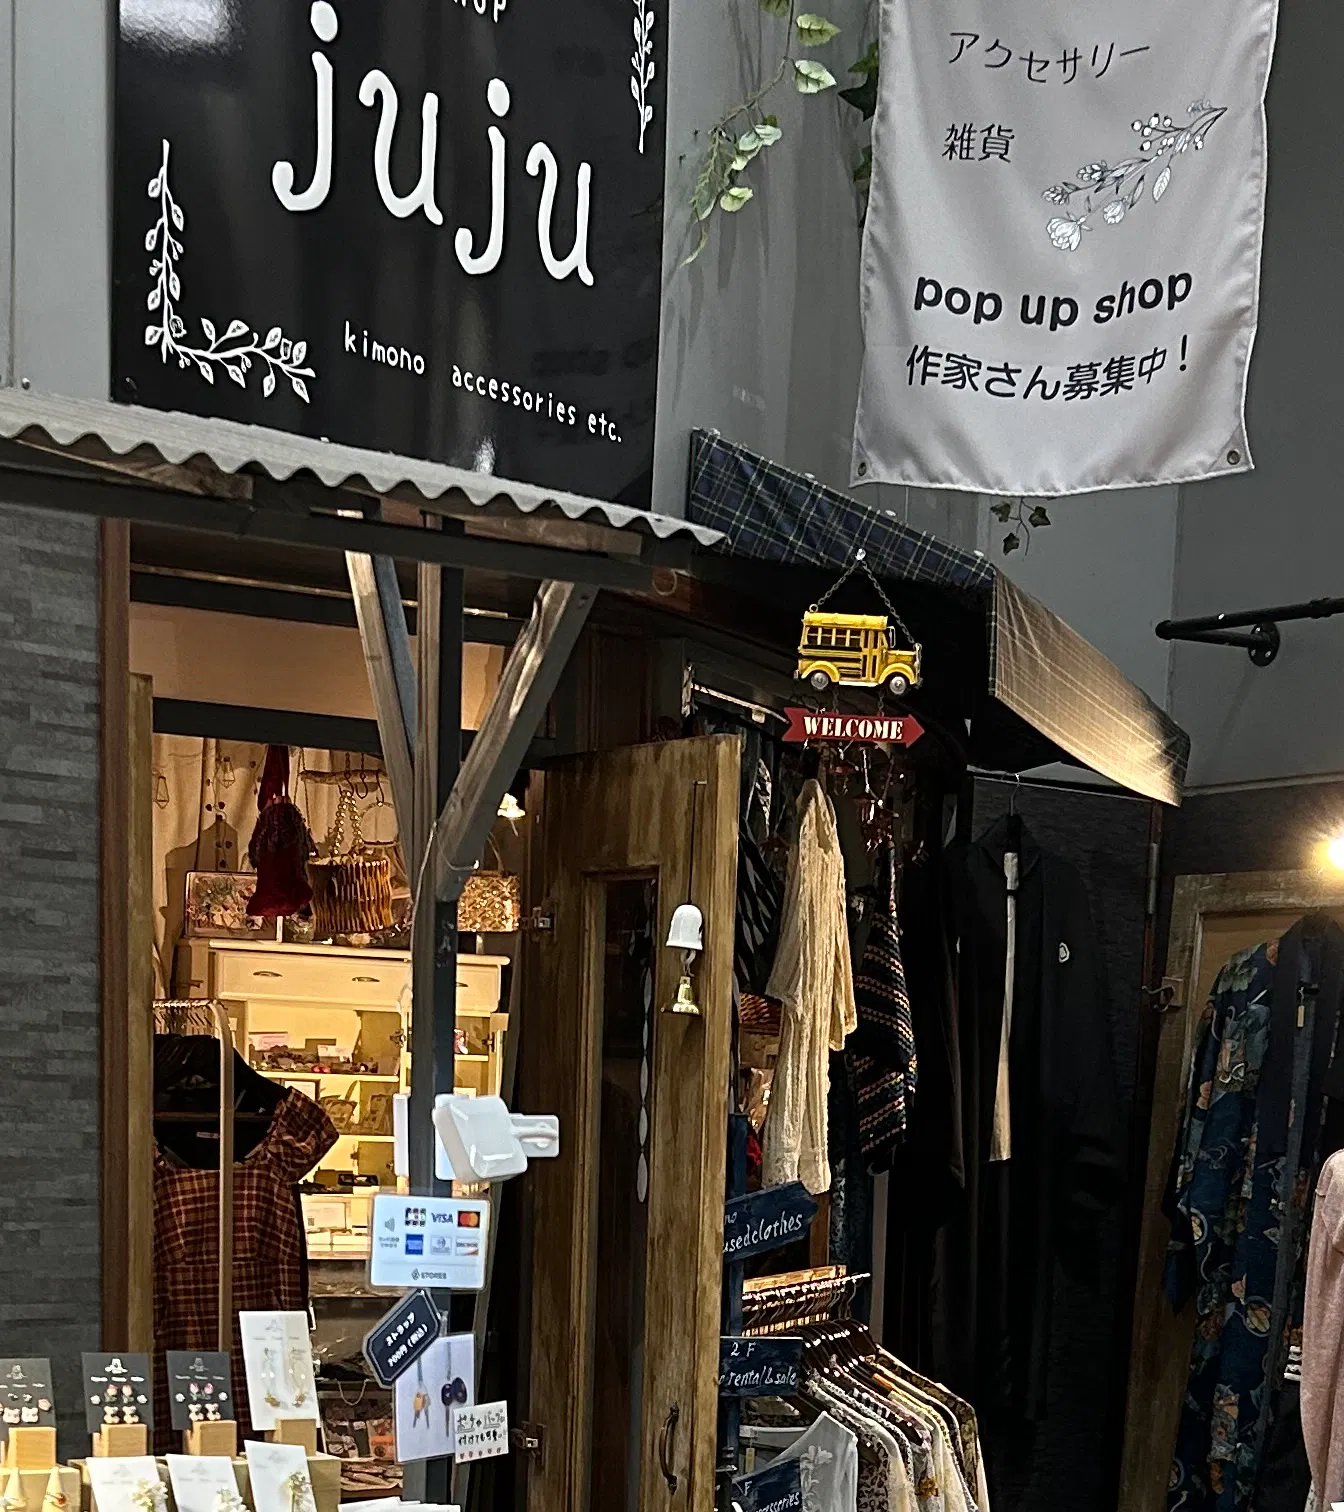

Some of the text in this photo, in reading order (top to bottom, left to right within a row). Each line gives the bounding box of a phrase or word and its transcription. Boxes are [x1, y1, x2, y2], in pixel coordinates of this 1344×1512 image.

[949, 31, 1151, 85] アクセサリー
[271, 0, 594, 286] juju
[941, 123, 1015, 164] 雑貨
[913, 271, 1193, 332] pop up shop
[343, 321, 623, 443] kimono accessories etc.
[803, 715, 904, 741] WELCOME
[431, 1212, 454, 1224] VISA
